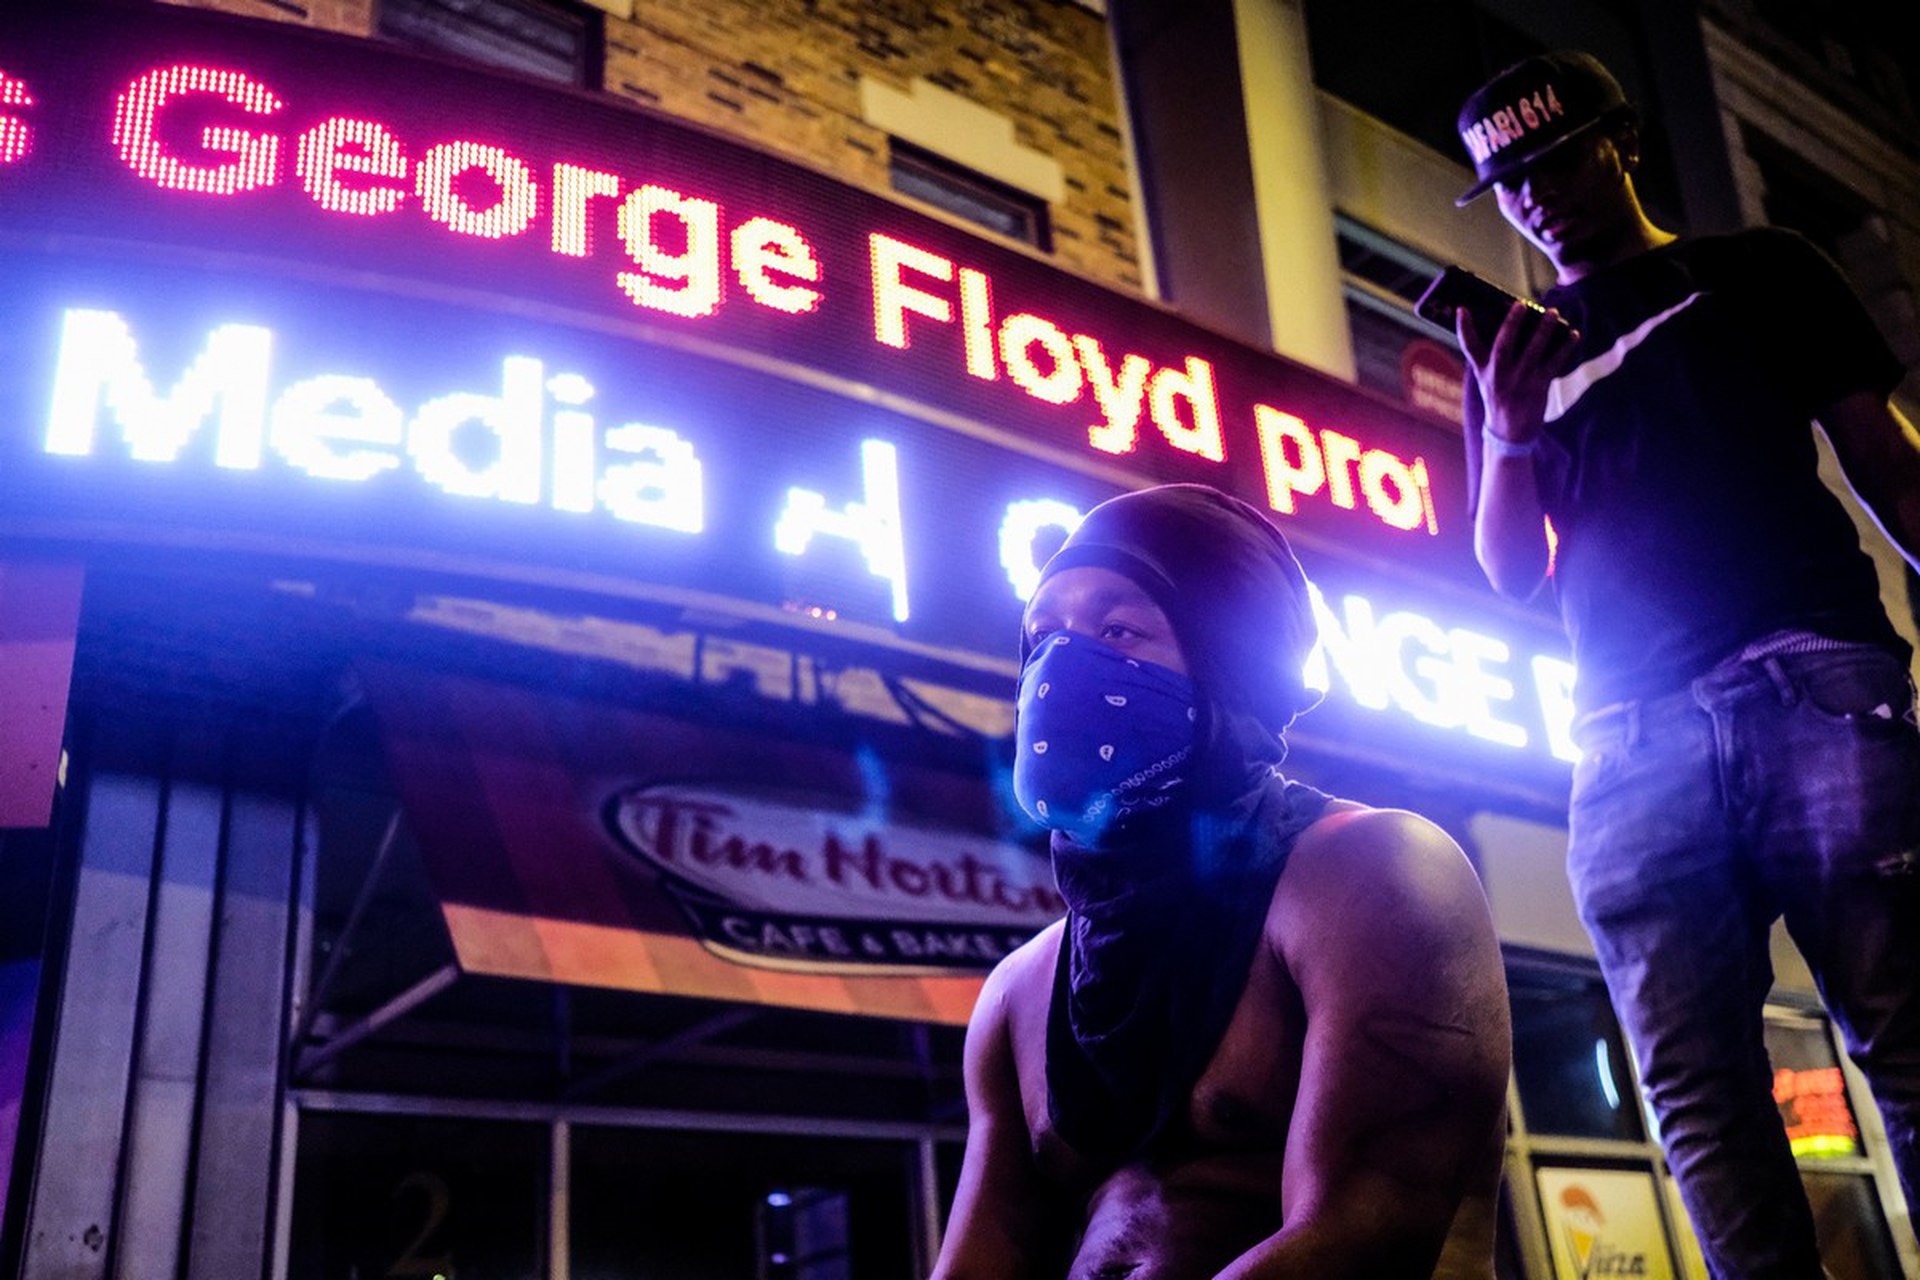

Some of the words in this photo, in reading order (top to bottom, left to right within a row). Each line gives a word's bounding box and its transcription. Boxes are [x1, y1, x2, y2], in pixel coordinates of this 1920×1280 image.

[112, 64, 823, 318] George
[868, 230, 1227, 463] Floyd
[44, 306, 704, 534] Media
[636, 796, 806, 882] Tim
[721, 916, 850, 955] CAFE
